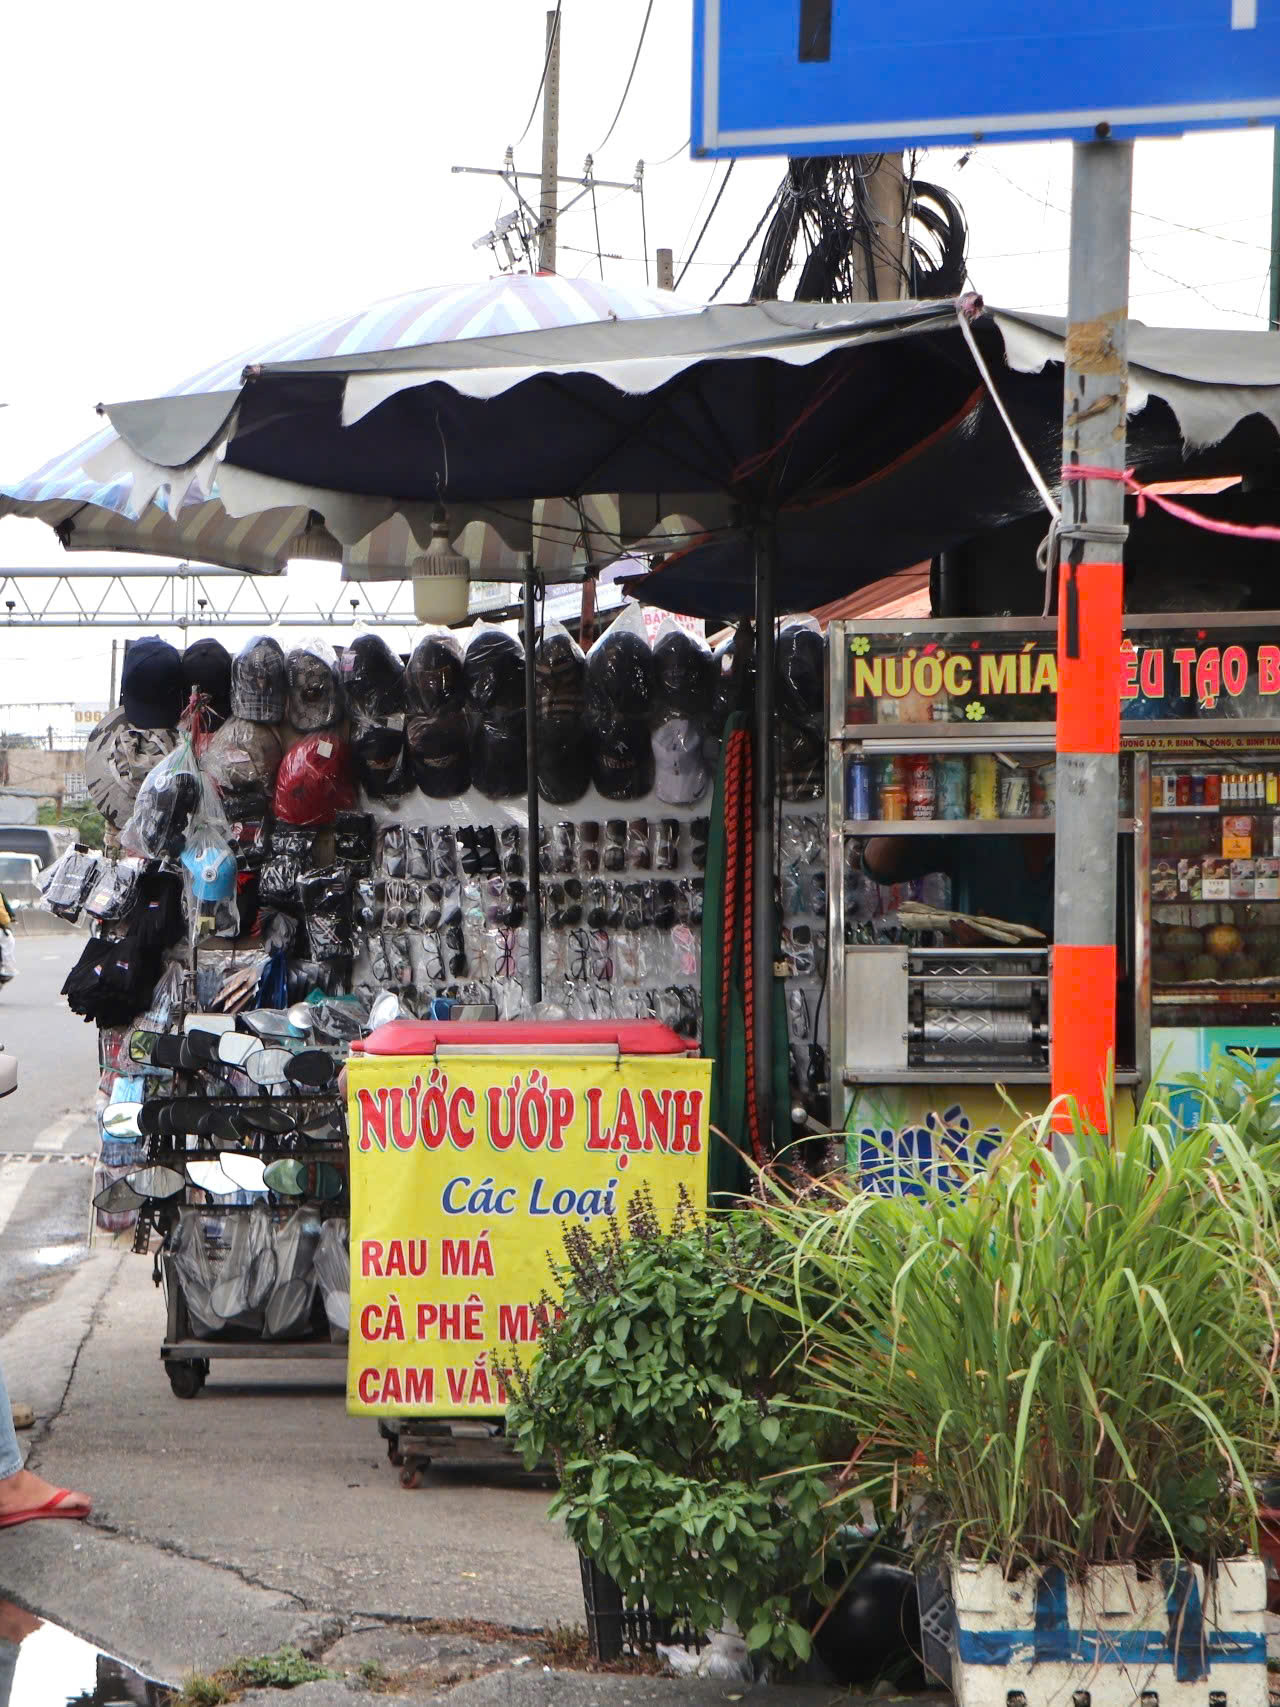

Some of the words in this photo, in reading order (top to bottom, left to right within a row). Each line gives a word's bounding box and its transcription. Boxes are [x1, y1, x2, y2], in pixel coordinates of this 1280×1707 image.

[854, 643, 973, 698] NƯỚC
[979, 641, 1058, 695] MÍA
[356, 1067, 476, 1151] NƯỚC
[487, 1068, 575, 1151] ƯỚP
[584, 1087, 704, 1171] LẠNH
[441, 1176, 517, 1215] Các
[528, 1178, 619, 1223] Loại
[361, 1240, 429, 1277] RAU
[440, 1230, 495, 1277] MÁ
[360, 1295, 406, 1342] CÀ
[417, 1295, 485, 1341] PHÊ
[358, 1368, 436, 1405] CAM
[446, 1351, 513, 1405] VẮT
